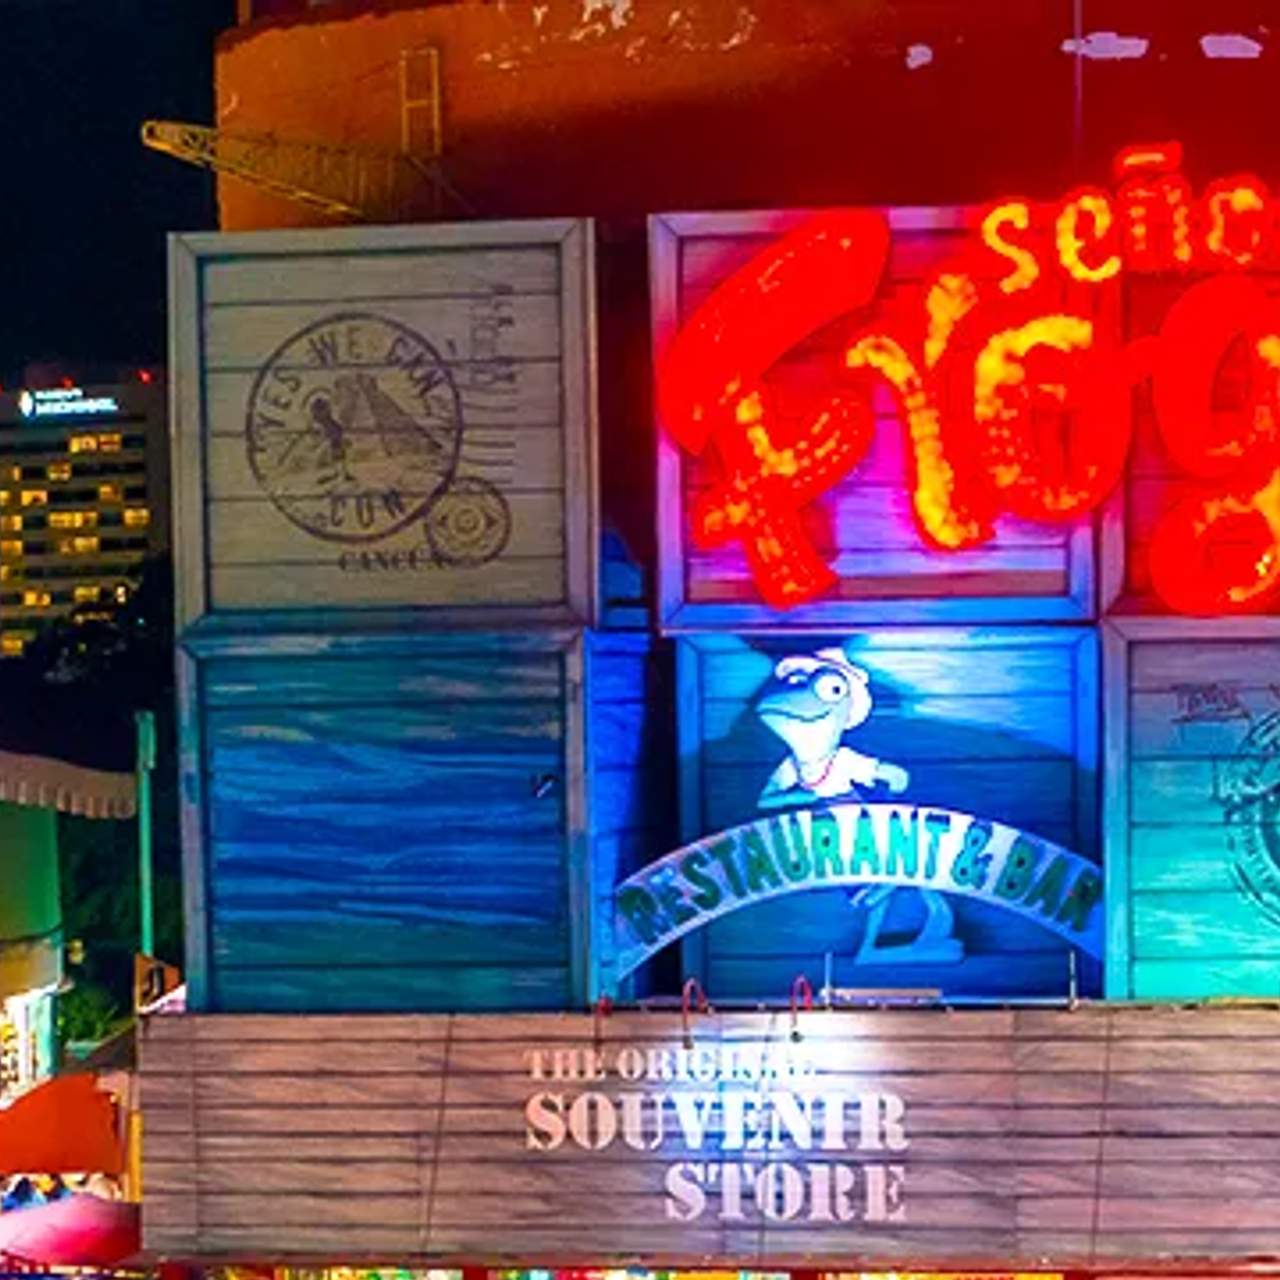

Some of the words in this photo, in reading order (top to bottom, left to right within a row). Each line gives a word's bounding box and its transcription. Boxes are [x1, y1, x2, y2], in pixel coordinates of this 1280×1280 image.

[620, 808, 952, 945] RESTAURANT
[949, 822, 992, 887] &
[996, 833, 1103, 934] BAR
[523, 1048, 607, 1082] THE
[525, 1091, 911, 1152] SOUVENIR
[663, 1161, 907, 1222] STORE
